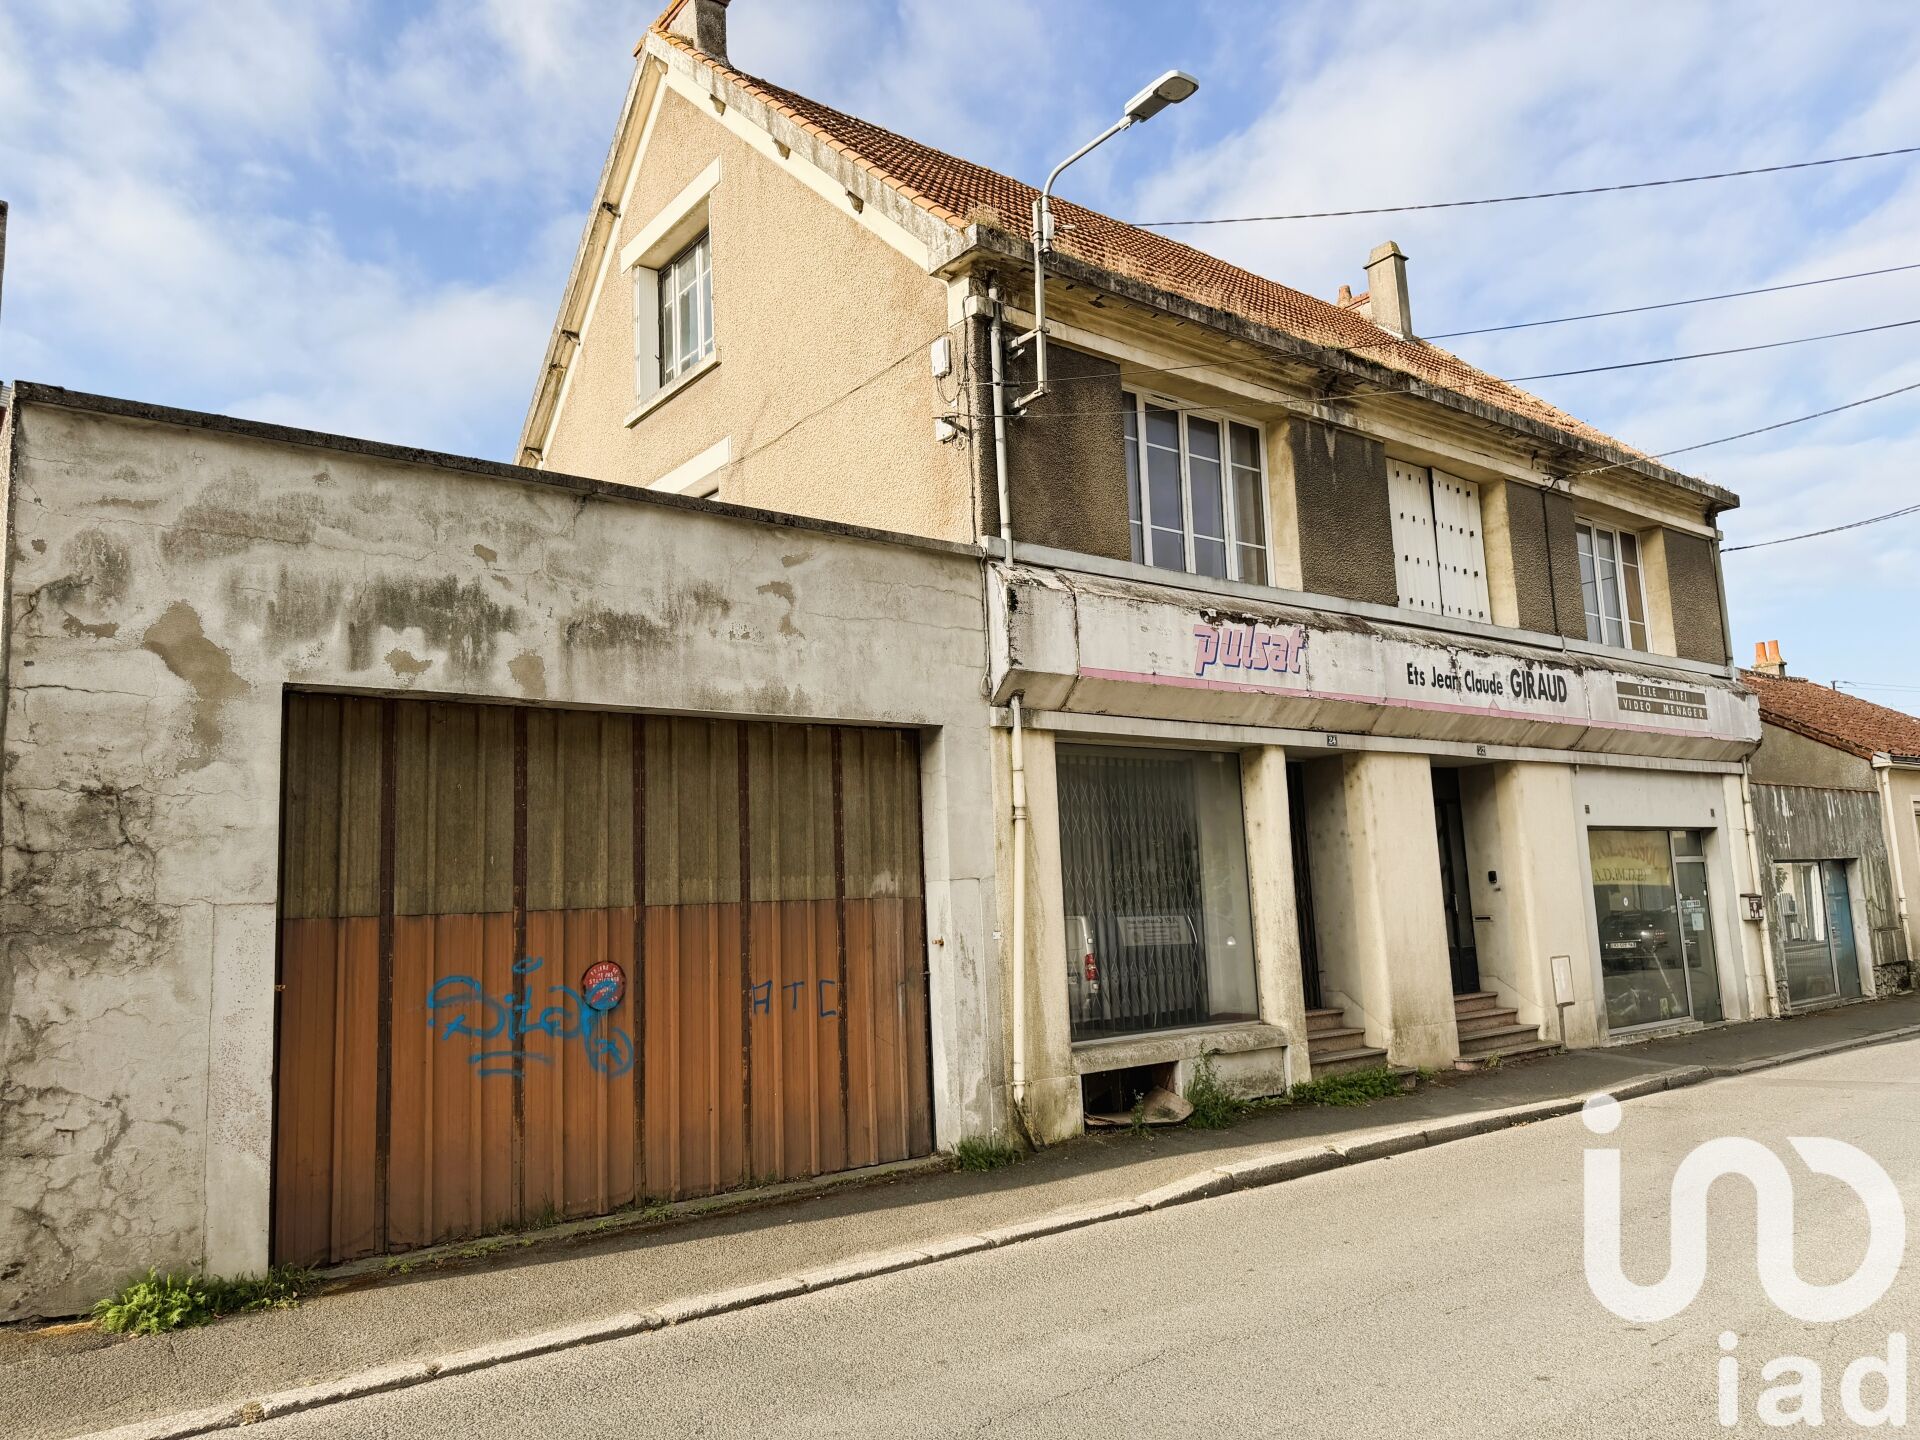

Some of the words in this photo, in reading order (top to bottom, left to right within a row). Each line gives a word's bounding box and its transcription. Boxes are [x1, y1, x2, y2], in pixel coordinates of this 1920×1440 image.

[1193, 624, 1305, 676] pulsat
[1406, 662, 1425, 687] Ets
[1431, 666, 1461, 690] Jean
[1464, 670, 1503, 696] Claude
[1510, 668, 1568, 703] GIRAUD
[1637, 685, 1657, 697] TELE
[1669, 690, 1688, 702] HIFI
[1622, 699, 1651, 712] VIDEO
[1663, 704, 1704, 719] MENAGER
